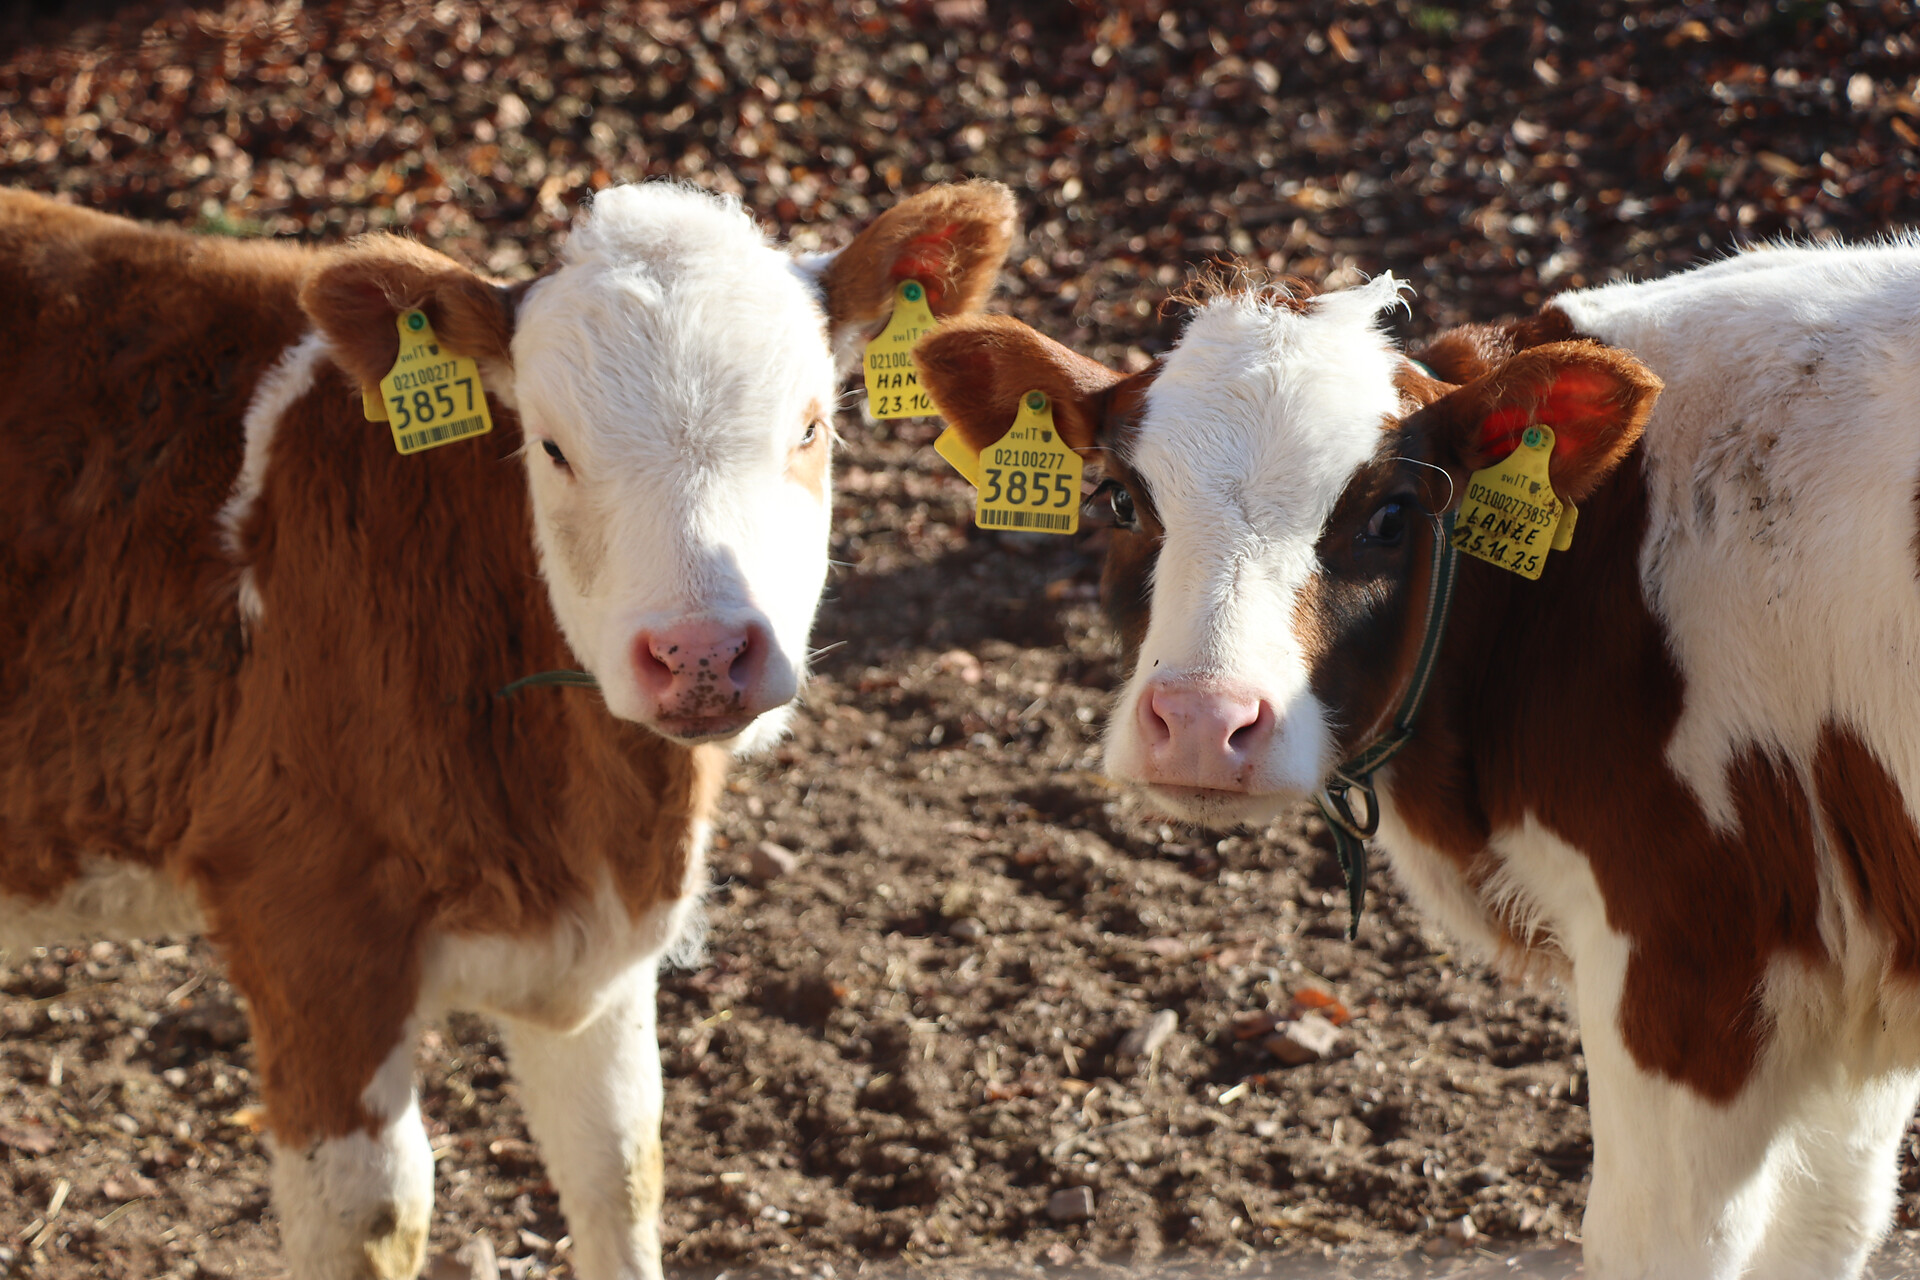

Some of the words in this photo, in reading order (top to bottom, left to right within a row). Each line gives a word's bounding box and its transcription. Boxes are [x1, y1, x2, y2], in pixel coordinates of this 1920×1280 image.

[393, 361, 458, 391] 02100277
[389, 377, 473, 430] 3857
[994, 448, 1065, 470] 02100277
[983, 468, 1073, 508] 3855
[1469, 483, 1553, 527] 021002773855
